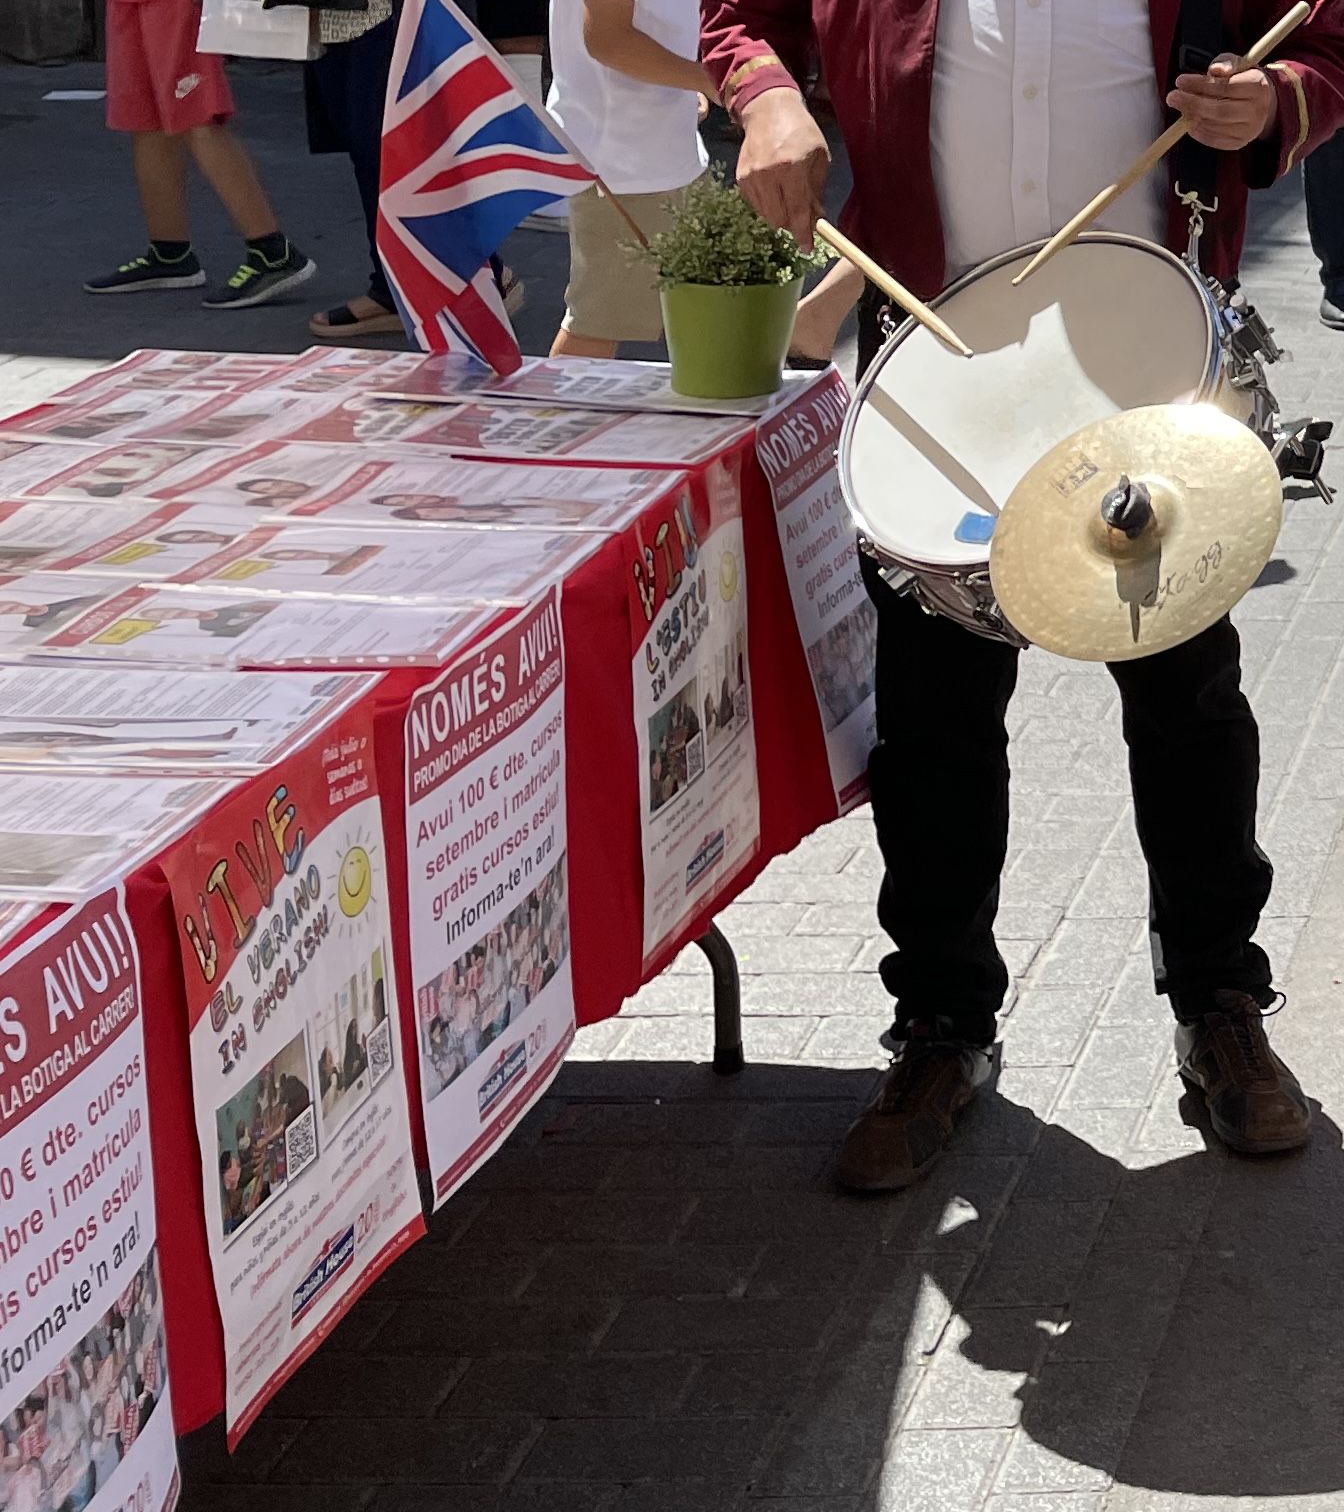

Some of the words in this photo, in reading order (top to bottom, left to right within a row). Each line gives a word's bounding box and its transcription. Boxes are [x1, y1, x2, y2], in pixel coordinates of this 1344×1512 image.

[786, 511, 808, 544] Avui
[808, 497, 823, 523] 100
[824, 491, 831, 511] €
[796, 524, 838, 569] setembre
[805, 562, 833, 601] gratis
[411, 651, 506, 759] NOMÉS
[518, 602, 558, 686] AVUI!
[414, 750, 451, 792] PROMO
[452, 737, 468, 765] DIA
[469, 727, 482, 753] DE
[483, 718, 496, 742] LA
[496, 695, 529, 732] BOTIGA
[416, 800, 454, 848] Avui
[458, 777, 484, 814] 100
[489, 766, 499, 790] €
[504, 751, 528, 781] dte.
[531, 710, 562, 757] cursos
[426, 810, 499, 880] setembre
[504, 797, 508, 820] i
[184, 784, 305, 984] VIVE
[433, 866, 478, 921] gratis
[482, 821, 529, 875] cursos
[533, 782, 560, 831] estiu!
[446, 854, 533, 946] Informa-te'n
[536, 825, 555, 865] ara!
[43, 913, 129, 1034] AVUI!
[210, 981, 244, 1033] EL
[247, 864, 321, 984] VERANO
[218, 1023, 248, 1075] IN
[252, 904, 329, 1033] ENGLISH!
[0, 1085, 22, 1120] LA
[21, 1043, 75, 1103] BOTIGA
[74, 1030, 91, 1062] AL
[90, 984, 135, 1045] CARRER!
[21, 1146, 36, 1182] €
[42, 1122, 82, 1166] dte.
[88, 1054, 141, 1126] cursos
[26, 1215, 98, 1298] cursos
[102, 1151, 144, 1223] estiu!
[49, 1188, 57, 1218] i
[0, 1260, 109, 1384] forma-te'n
[113, 1210, 141, 1270] ara!
